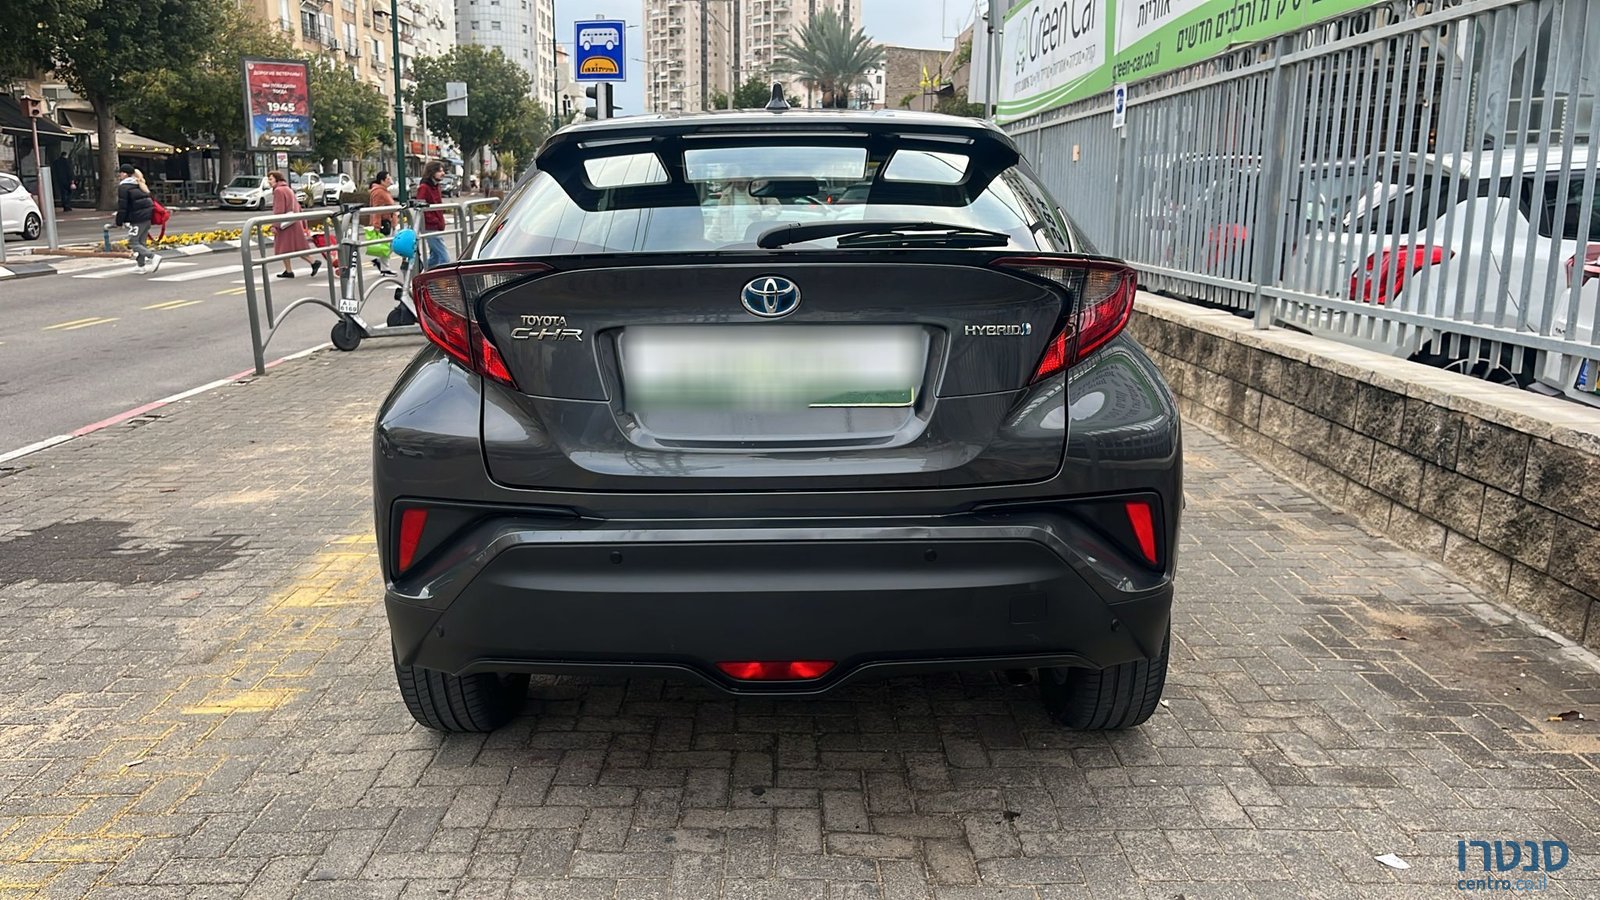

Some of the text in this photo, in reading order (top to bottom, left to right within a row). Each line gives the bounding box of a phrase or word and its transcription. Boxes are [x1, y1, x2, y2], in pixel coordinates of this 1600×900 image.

[1029, 1, 1068, 62] Green
[1176, 18, 1213, 53] חדשים
[267, 102, 296, 112] 1945
[270, 136, 300, 146] 2024
[128, 226, 139, 236] 23
[520, 315, 567, 327] TOYOTA
[511, 327, 583, 341] C-HR
[964, 324, 1021, 336] HYBRID
